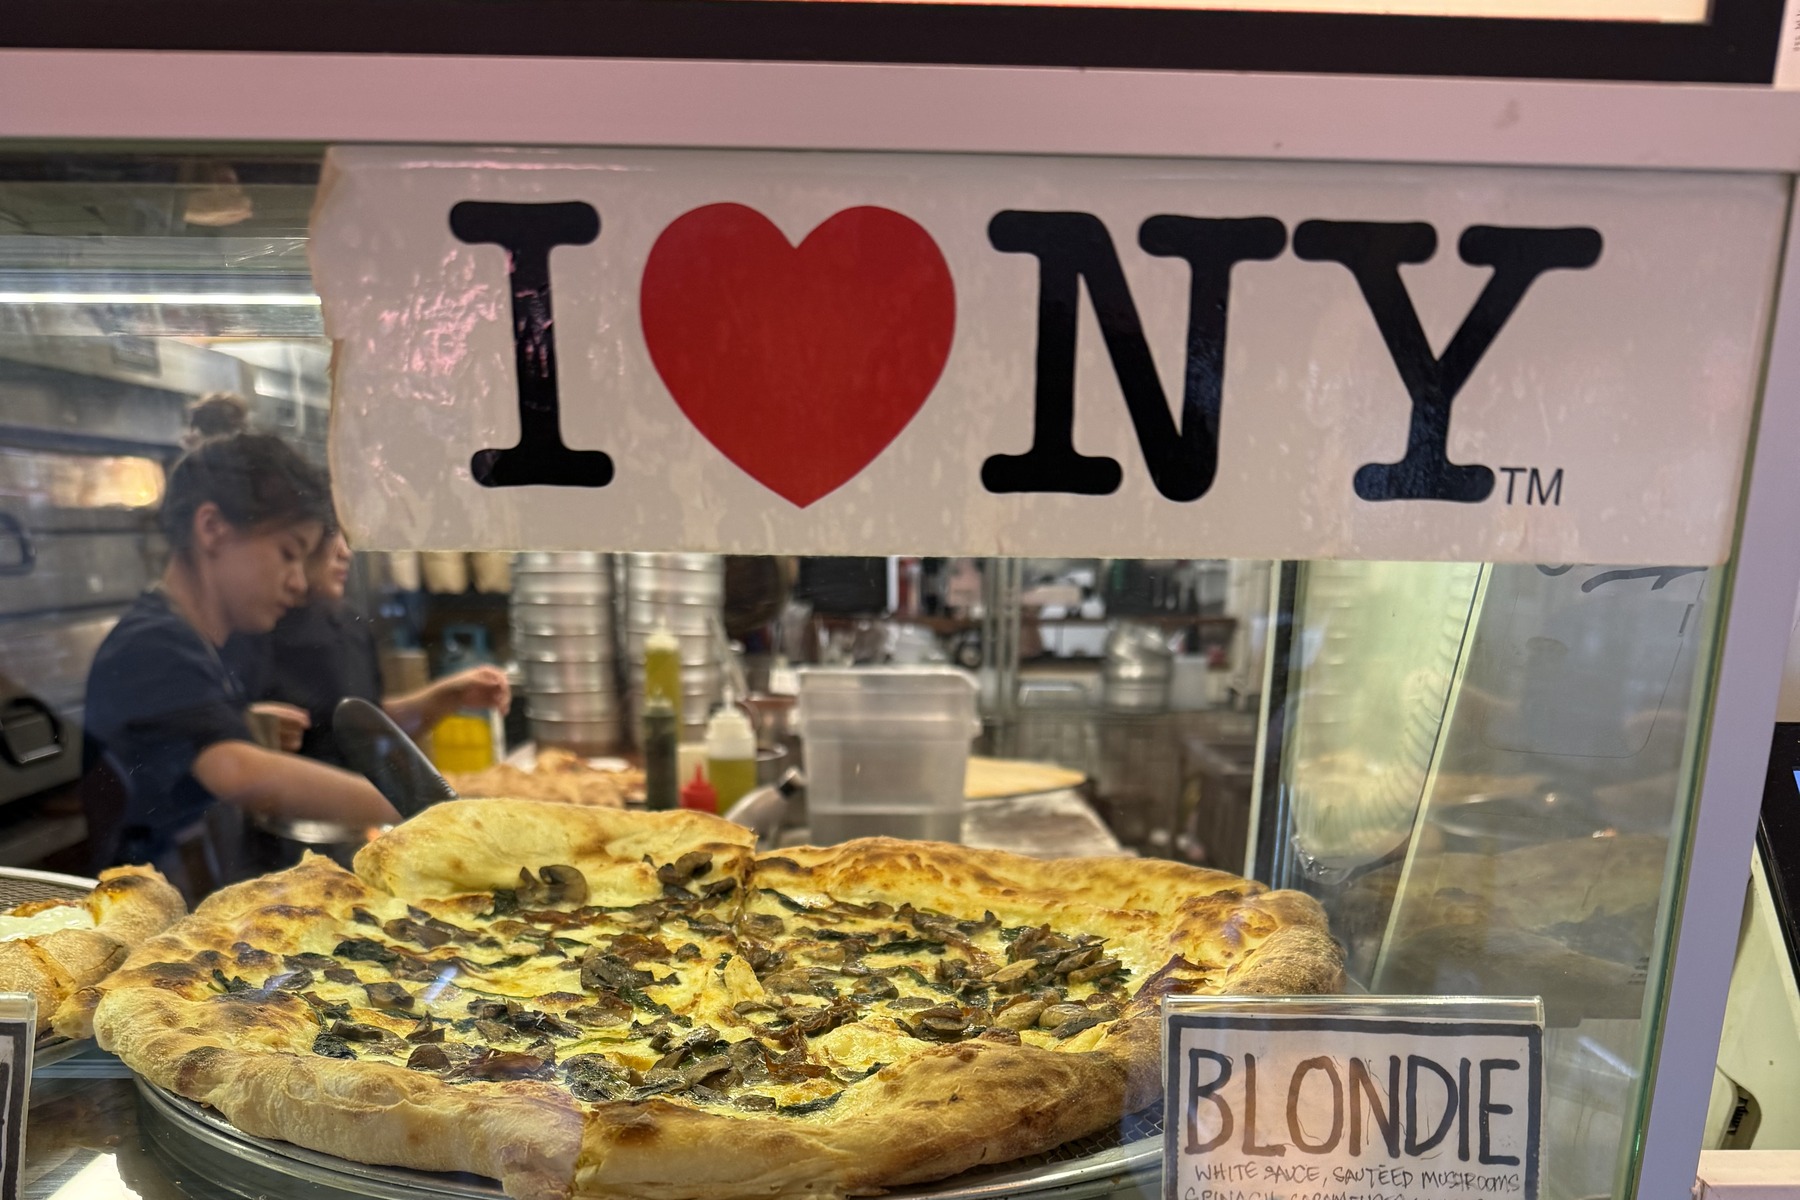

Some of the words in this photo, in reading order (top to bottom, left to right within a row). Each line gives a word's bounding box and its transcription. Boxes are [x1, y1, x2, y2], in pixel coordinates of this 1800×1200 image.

[449, 200, 615, 488] I
[1184, 1048, 1521, 1166] BLONDIE
[1195, 1161, 1258, 1183] WHITE
